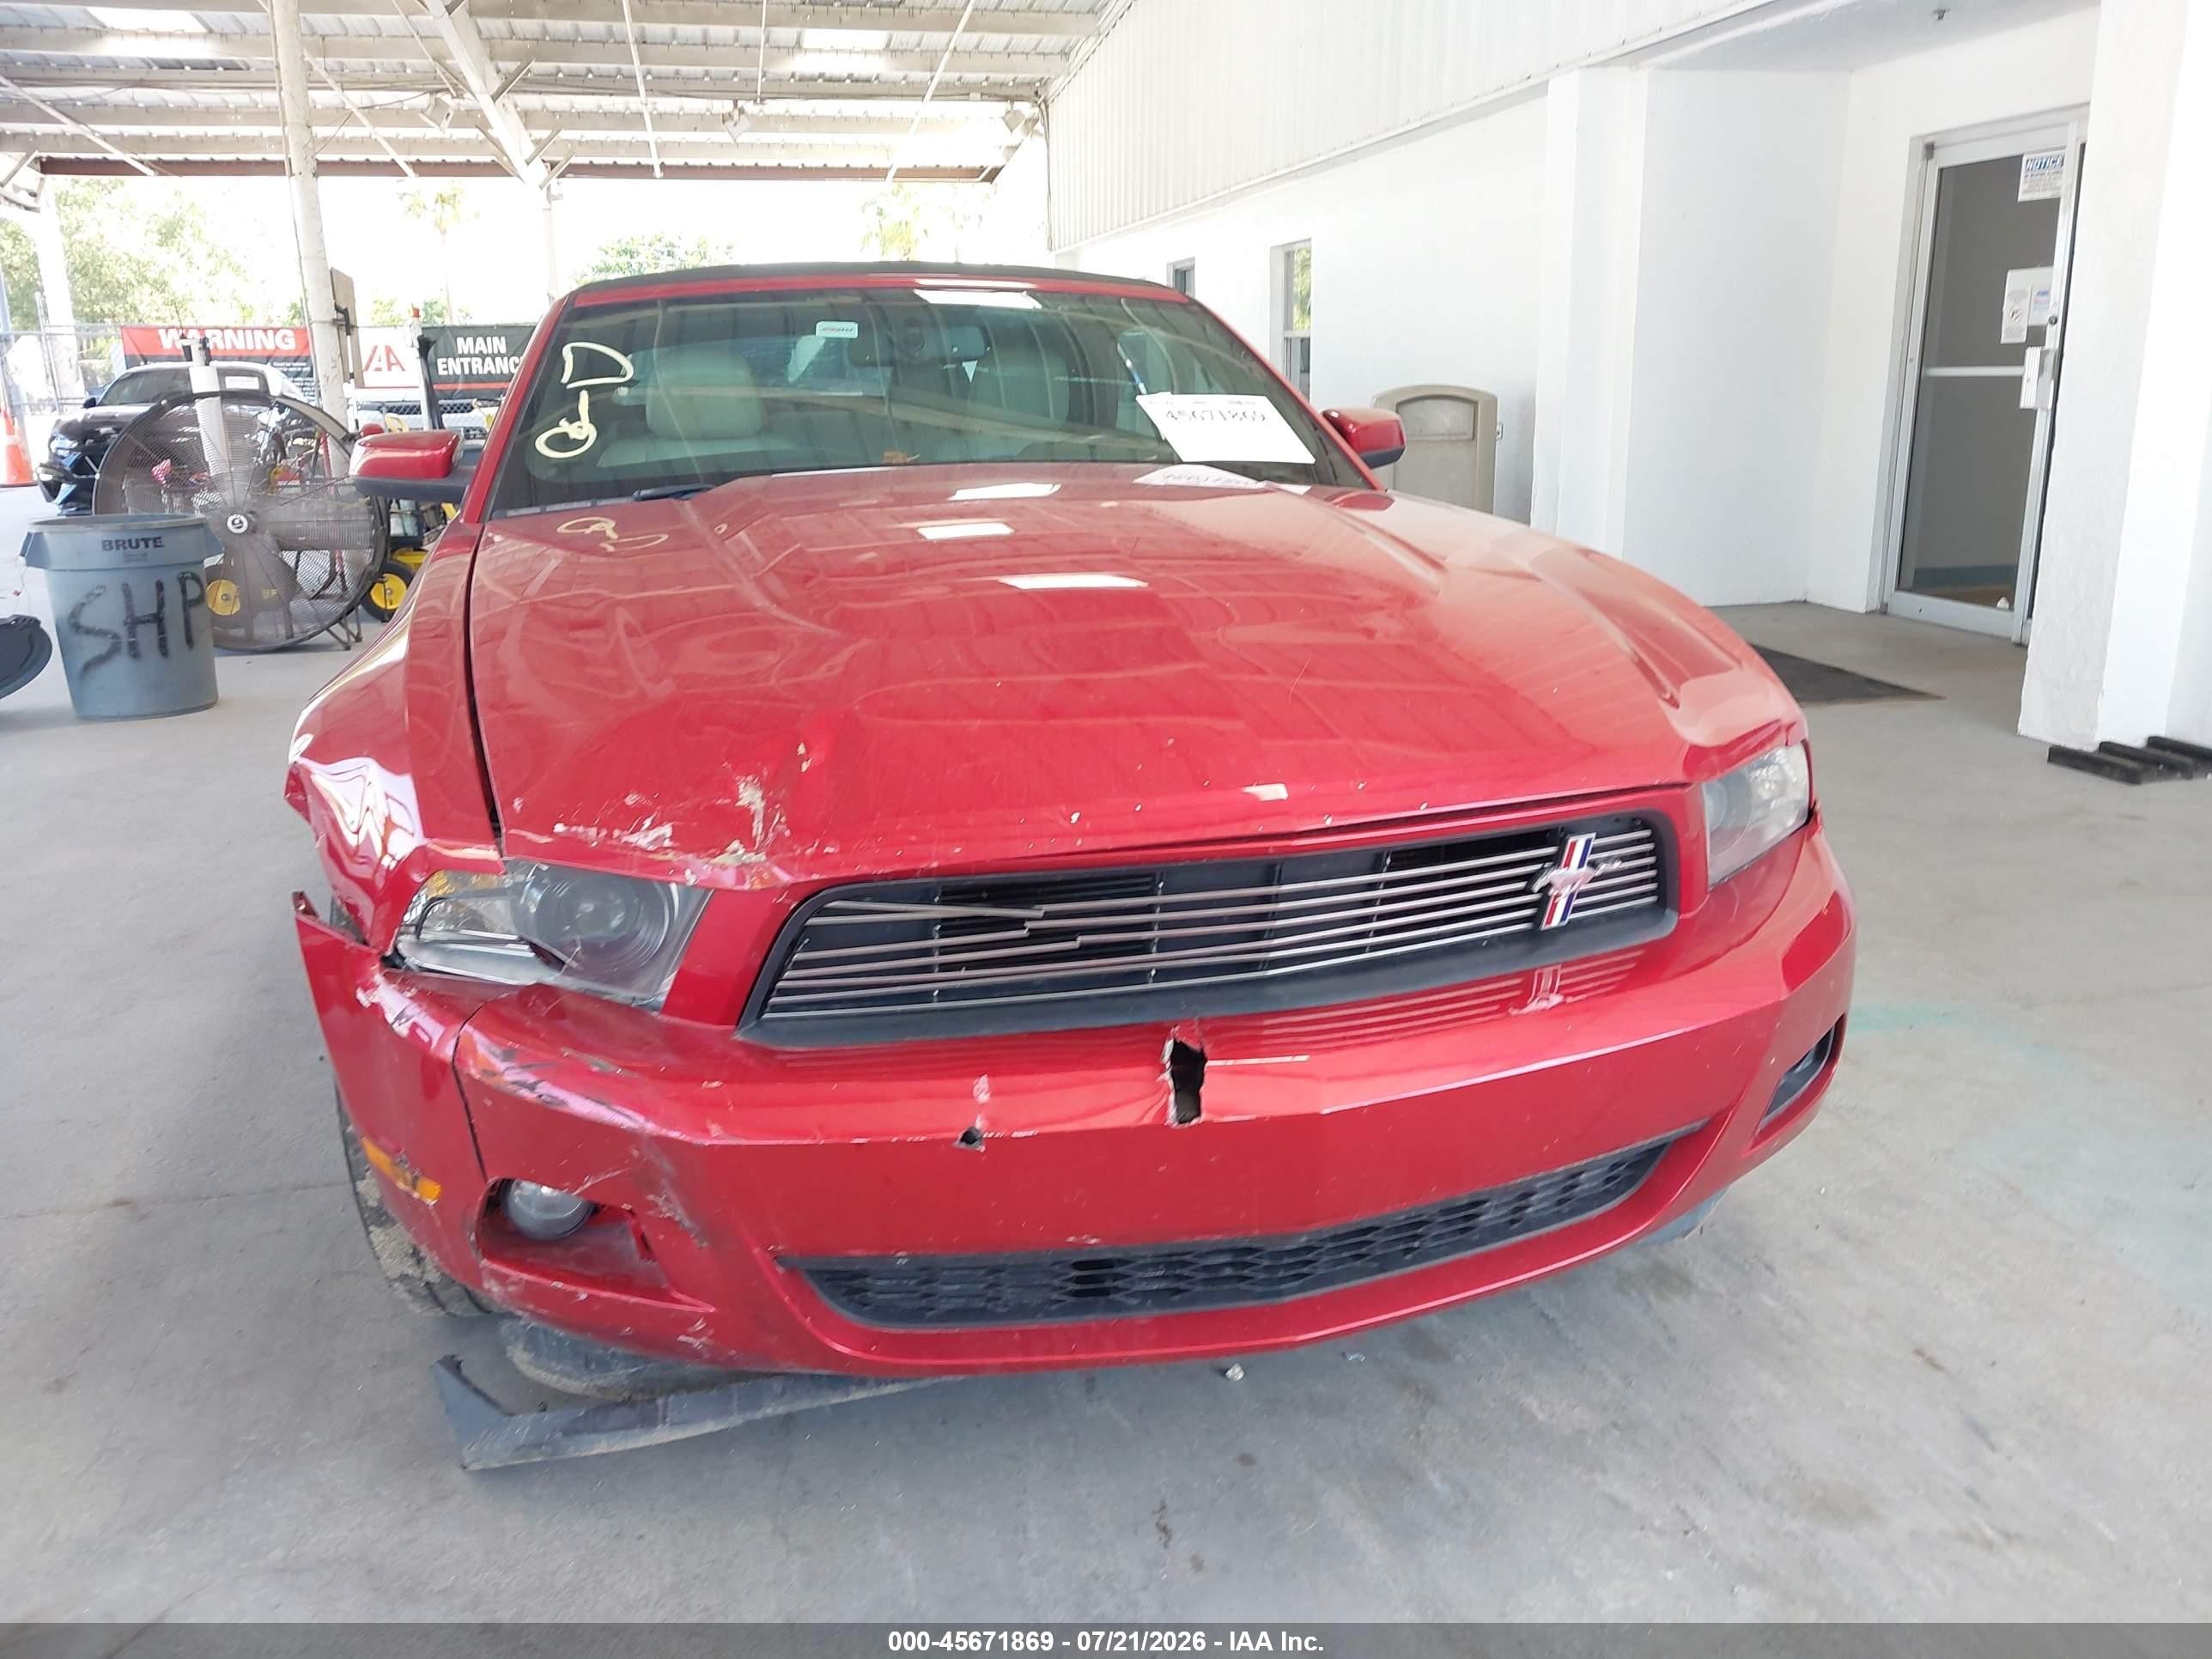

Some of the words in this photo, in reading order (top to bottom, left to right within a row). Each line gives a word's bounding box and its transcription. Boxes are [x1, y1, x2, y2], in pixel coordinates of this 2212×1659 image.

[157, 328, 296, 351] WARNING
[457, 336, 507, 355] MAIN
[436, 356, 521, 376] ENTRANC
[101, 536, 165, 552] BRUTE
[68, 570, 206, 681] SHP
